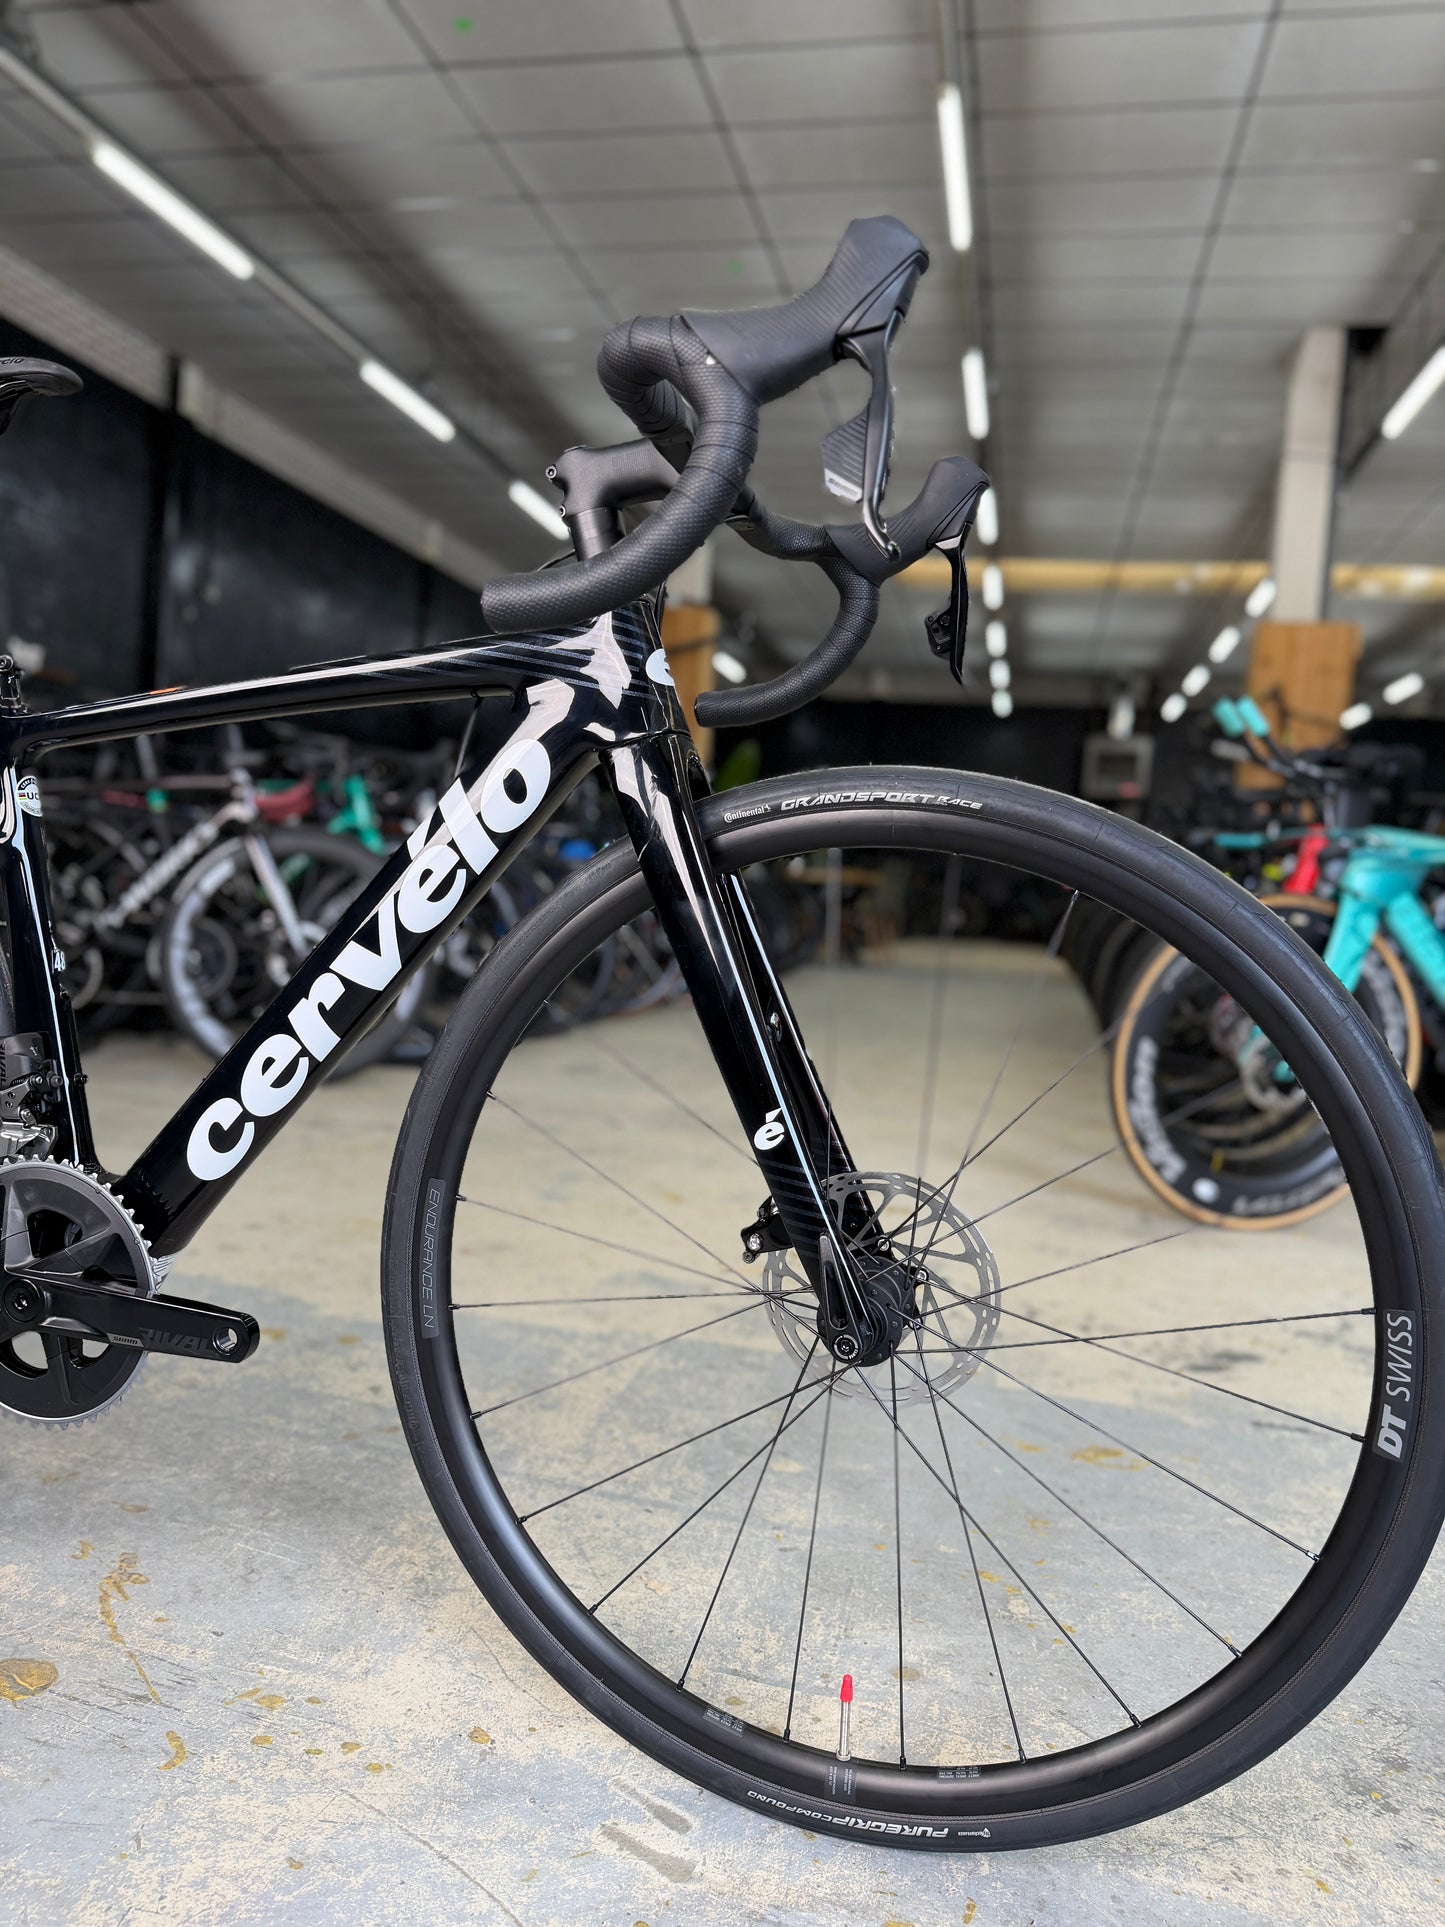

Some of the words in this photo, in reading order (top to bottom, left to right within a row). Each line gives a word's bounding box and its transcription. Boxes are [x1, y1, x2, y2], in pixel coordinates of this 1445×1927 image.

[724, 804, 765, 823] Continental
[936, 795, 983, 810] RACE
[186, 738, 552, 1182] cervélo
[422, 1188, 441, 1300] ENDURANCE
[423, 1305, 435, 1328] LN
[1386, 1312, 1413, 1402] SWISS
[1377, 1403, 1407, 1459] DT
